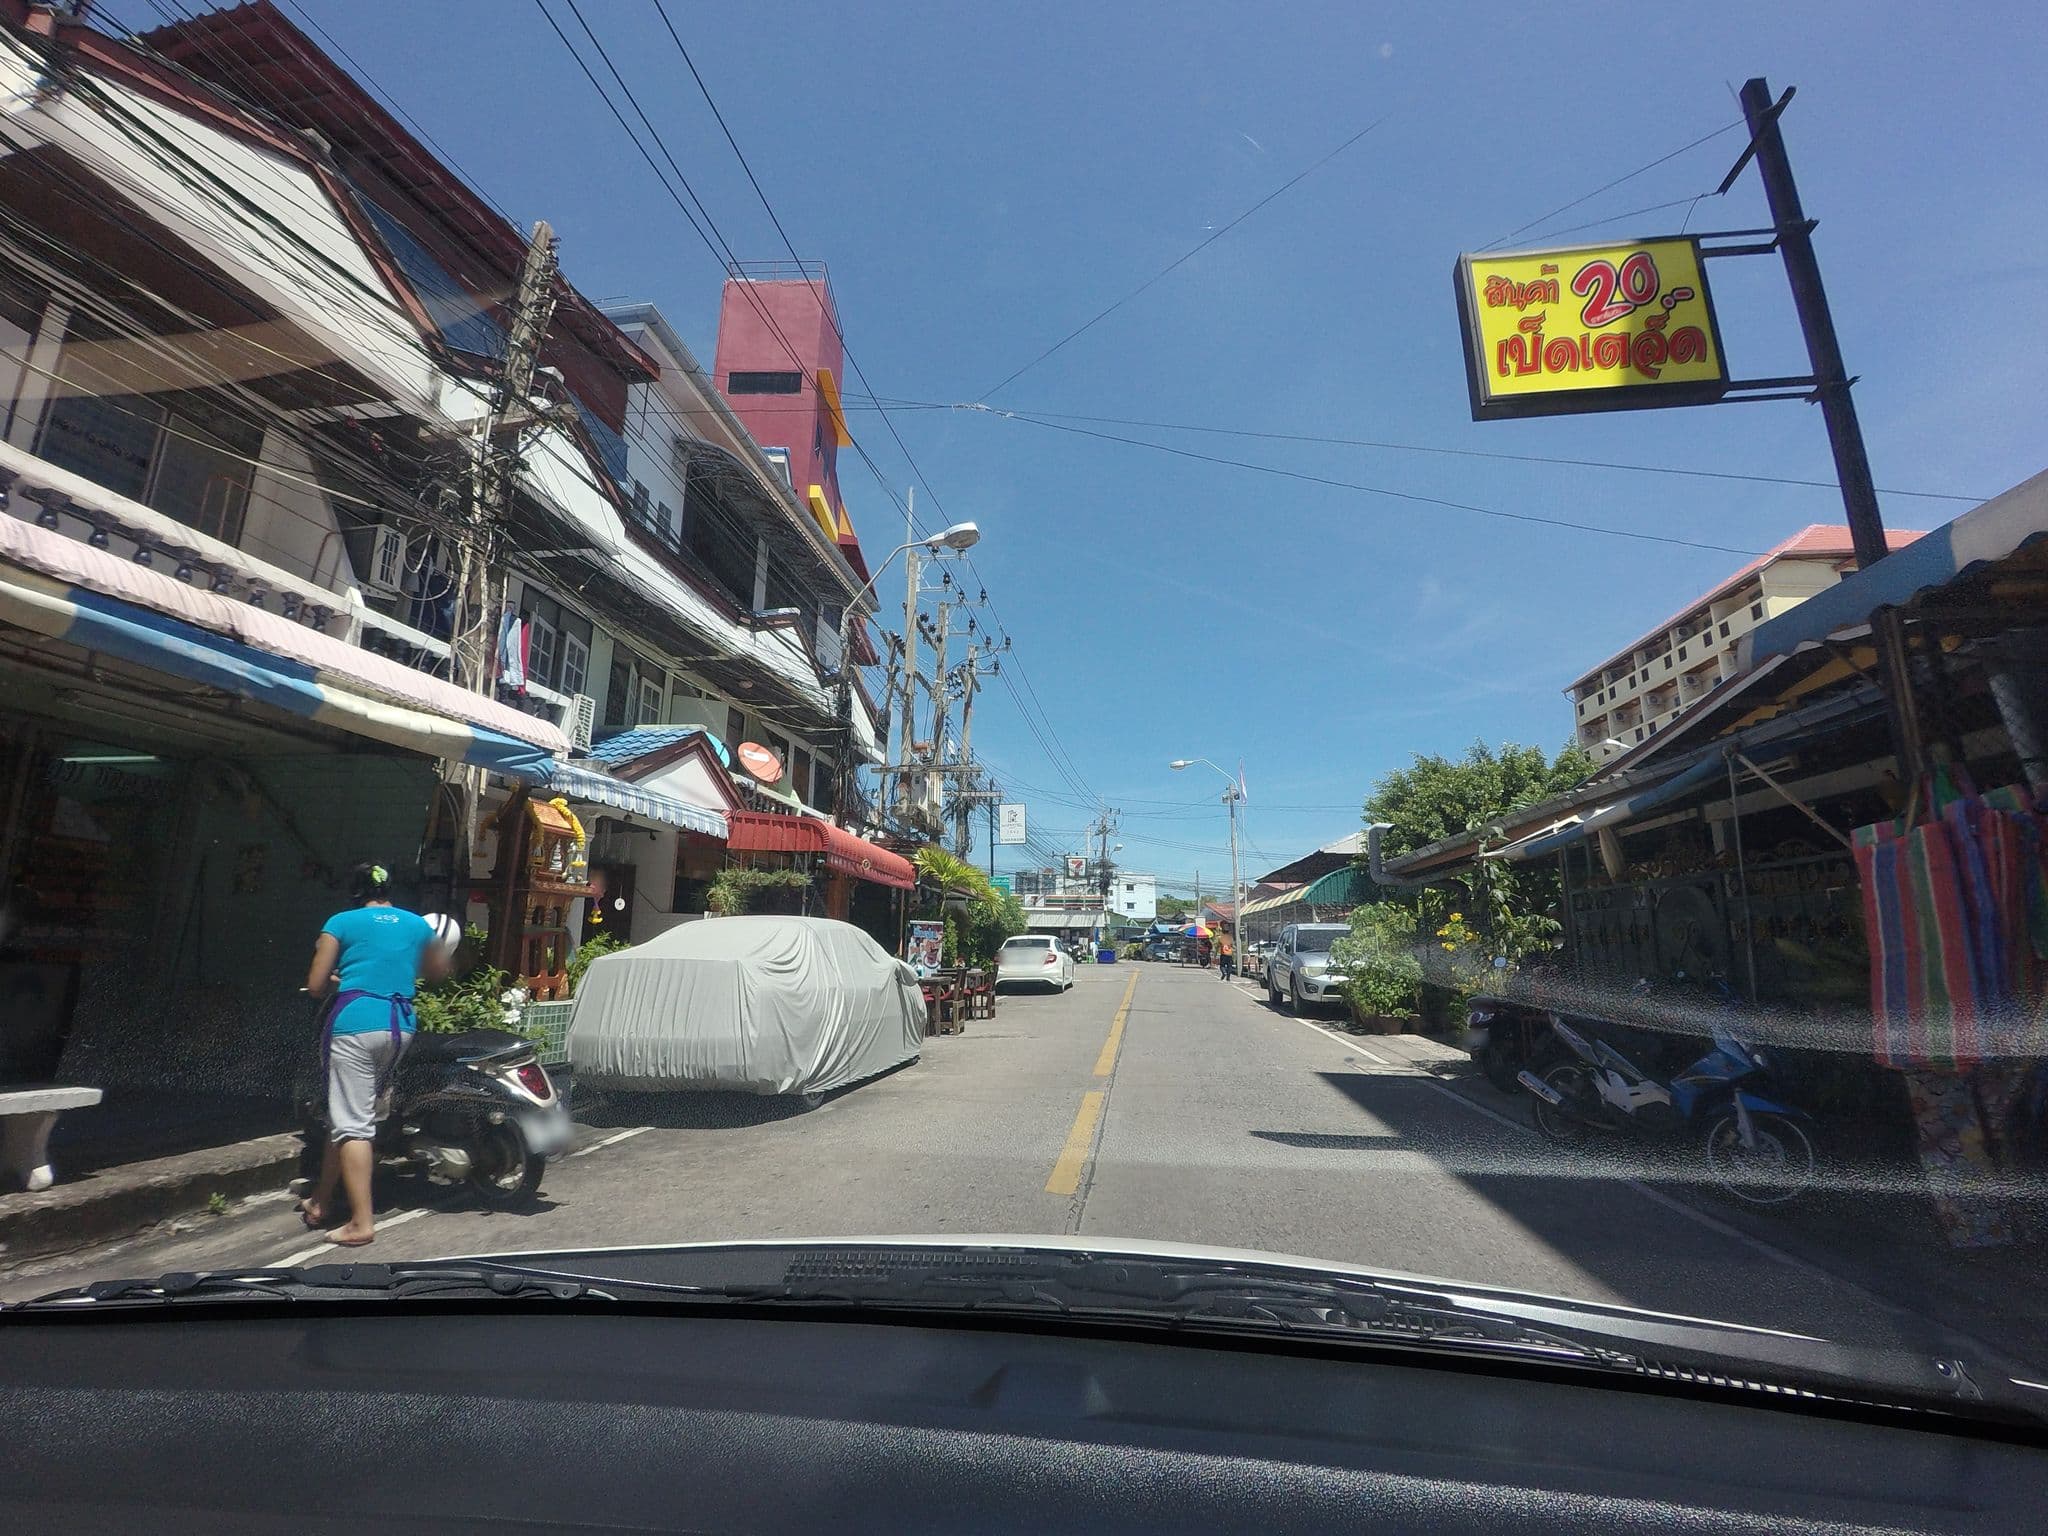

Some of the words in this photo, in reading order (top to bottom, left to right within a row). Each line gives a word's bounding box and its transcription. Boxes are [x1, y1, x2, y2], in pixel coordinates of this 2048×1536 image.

[1485, 264, 1559, 311] สินค้า
[1497, 310, 1707, 379] เบ็ดเตล็ด
